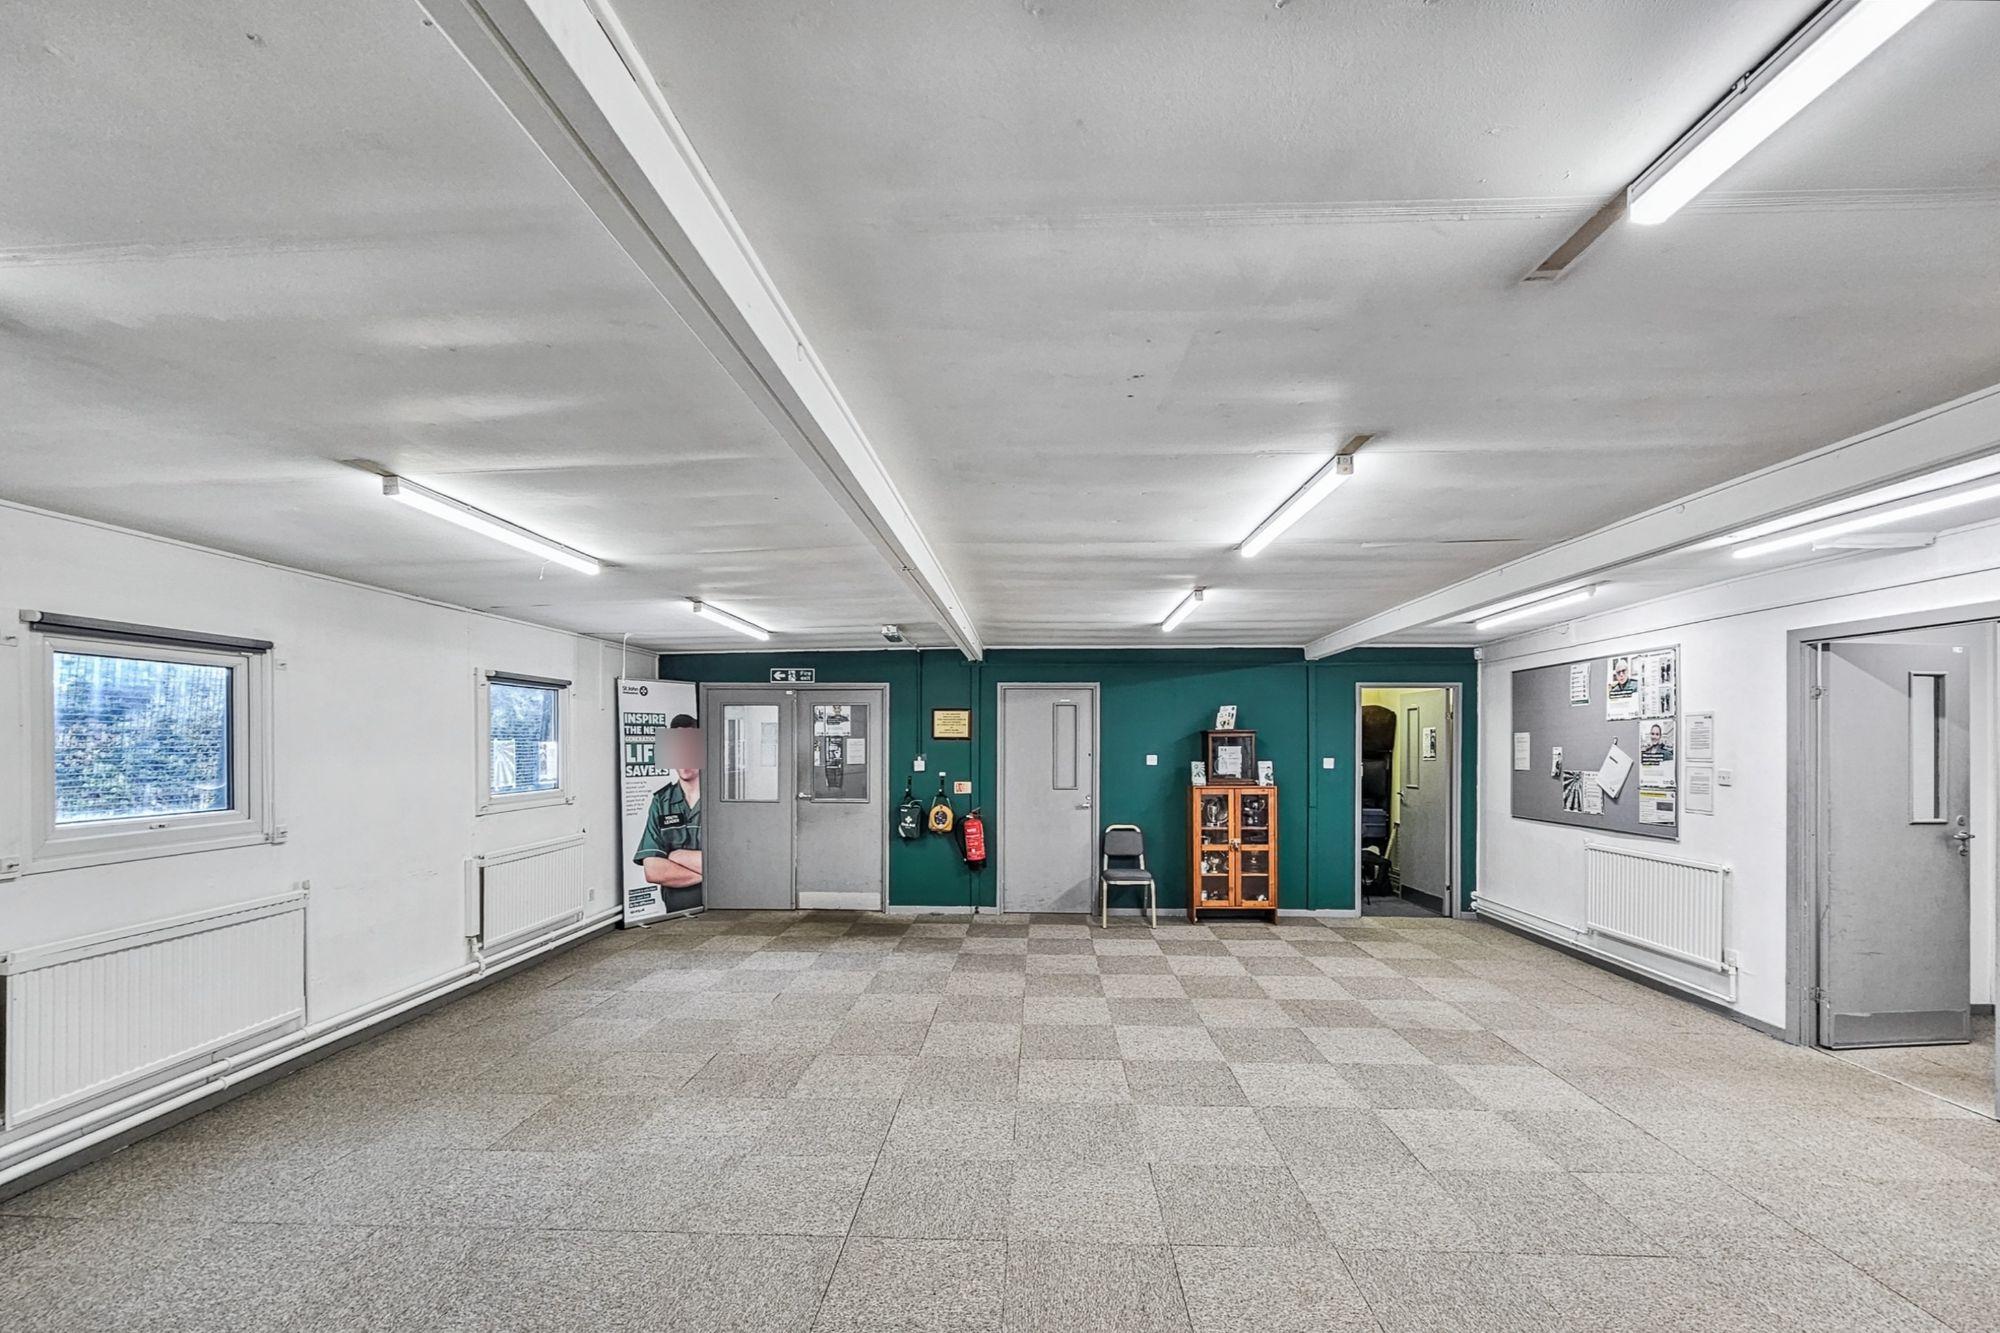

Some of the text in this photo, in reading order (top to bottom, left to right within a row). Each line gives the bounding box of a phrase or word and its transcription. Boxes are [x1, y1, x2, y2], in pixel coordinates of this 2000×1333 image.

[624, 714, 665, 724] INSPIRE
[625, 725, 642, 735] THE
[626, 744, 654, 763] LIF
[626, 765, 669, 776] SAVERS
